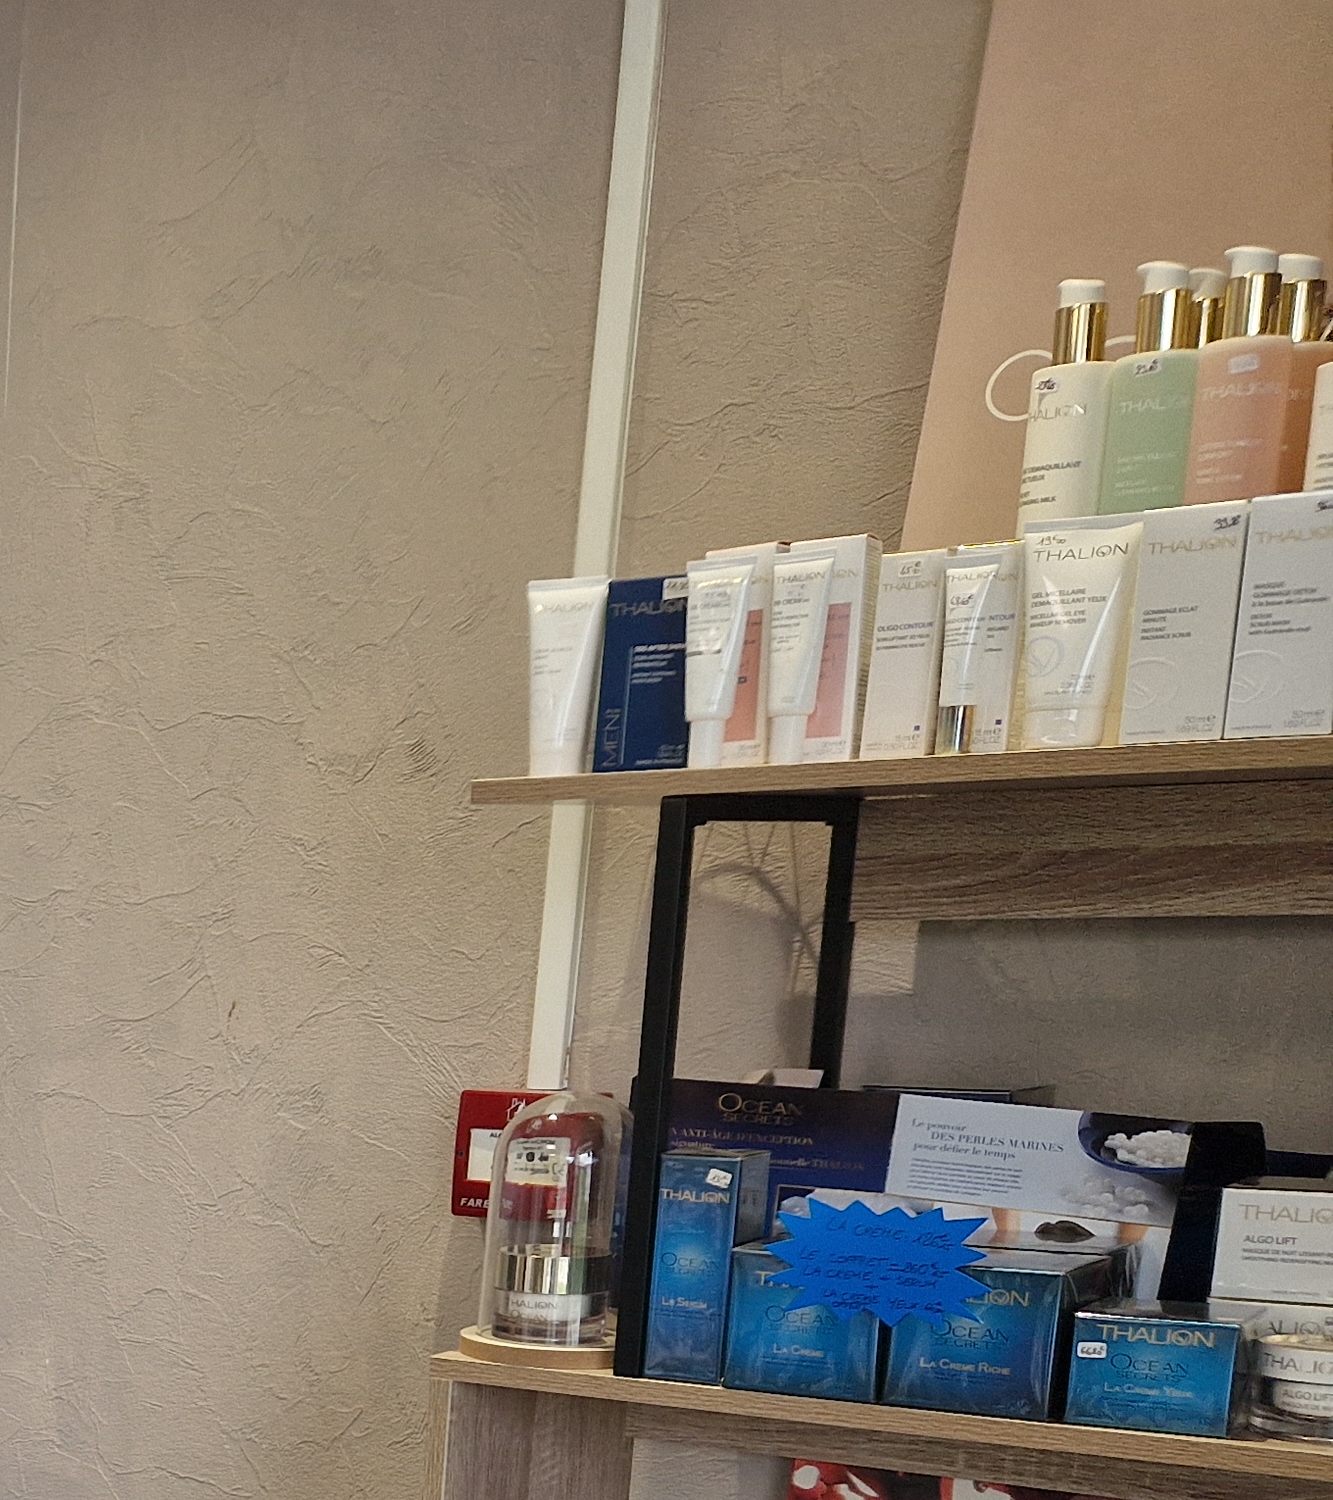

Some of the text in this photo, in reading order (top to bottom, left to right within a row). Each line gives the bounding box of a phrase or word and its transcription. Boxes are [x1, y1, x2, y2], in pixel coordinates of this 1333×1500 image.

[1033, 542, 1130, 562] THALION
[1148, 534, 1237, 557] THALION
[717, 1092, 804, 1117] OCEAN
[911, 1118, 967, 1133] Le pouvoir
[913, 1141, 1017, 1162] pour défier le temps
[931, 1131, 1065, 1153] DES PERLES MARINES
[659, 1188, 730, 1204] THALION
[1242, 1234, 1298, 1247] ALGO LIFT
[1097, 1323, 1215, 1349] THALION
[978, 1361, 1012, 1376] RICHE
[1110, 1352, 1191, 1377] OCEAN
